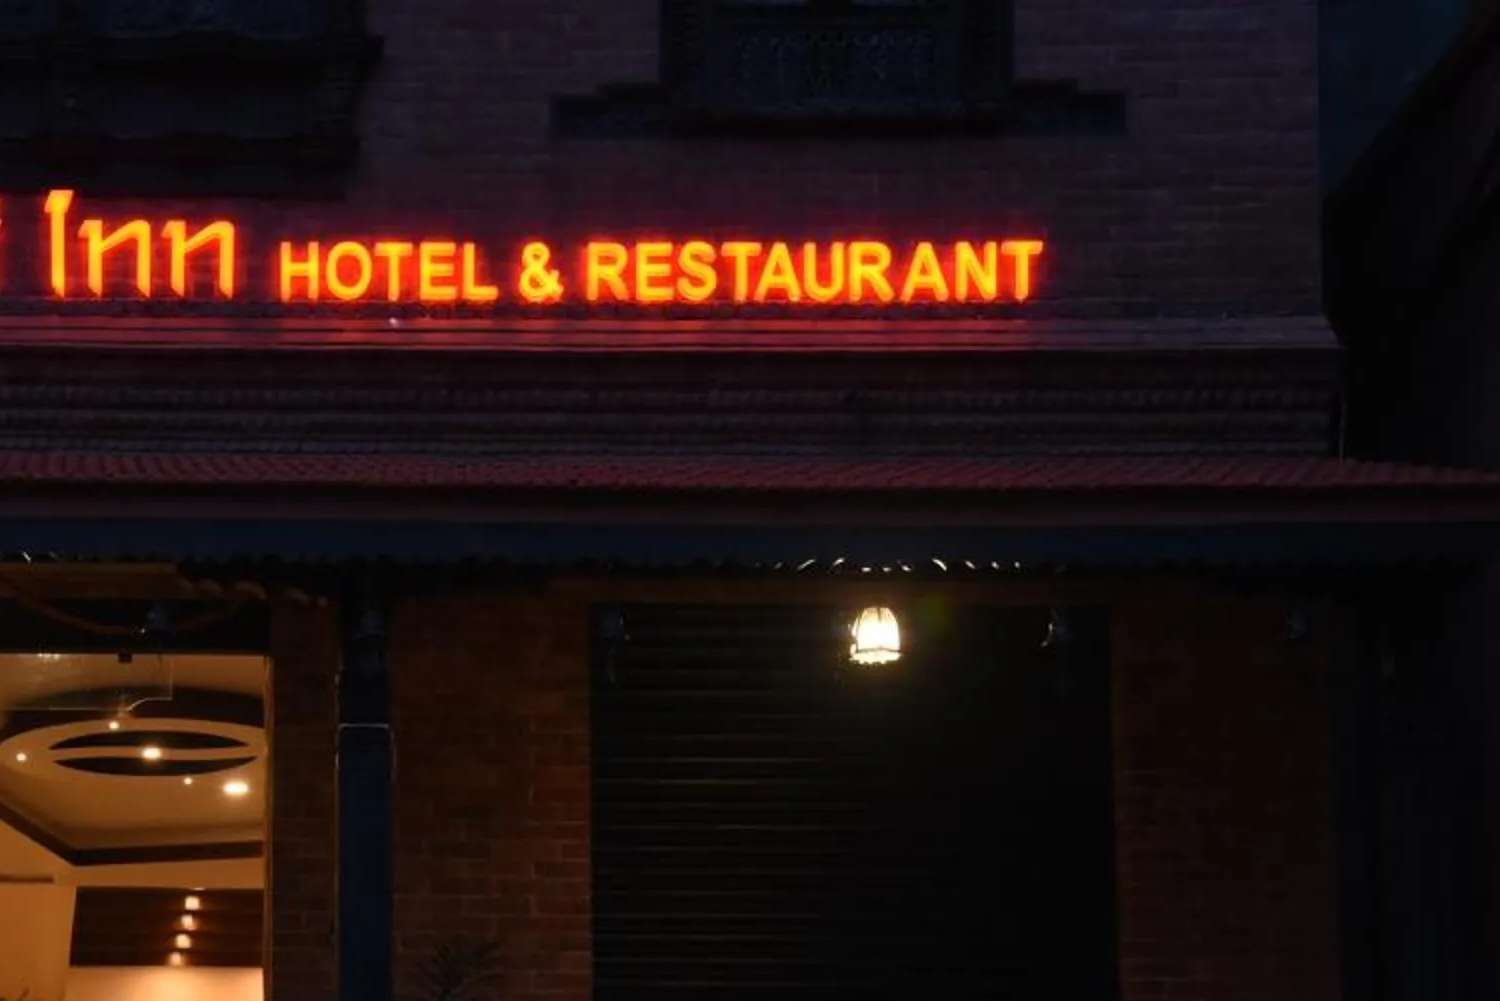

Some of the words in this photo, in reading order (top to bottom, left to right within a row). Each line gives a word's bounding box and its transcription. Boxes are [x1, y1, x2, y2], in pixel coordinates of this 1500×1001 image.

[44, 188, 236, 298] Inn
[278, 240, 499, 302] HOTEL
[517, 240, 566, 304] &
[583, 239, 1045, 304] RESTAURANT
